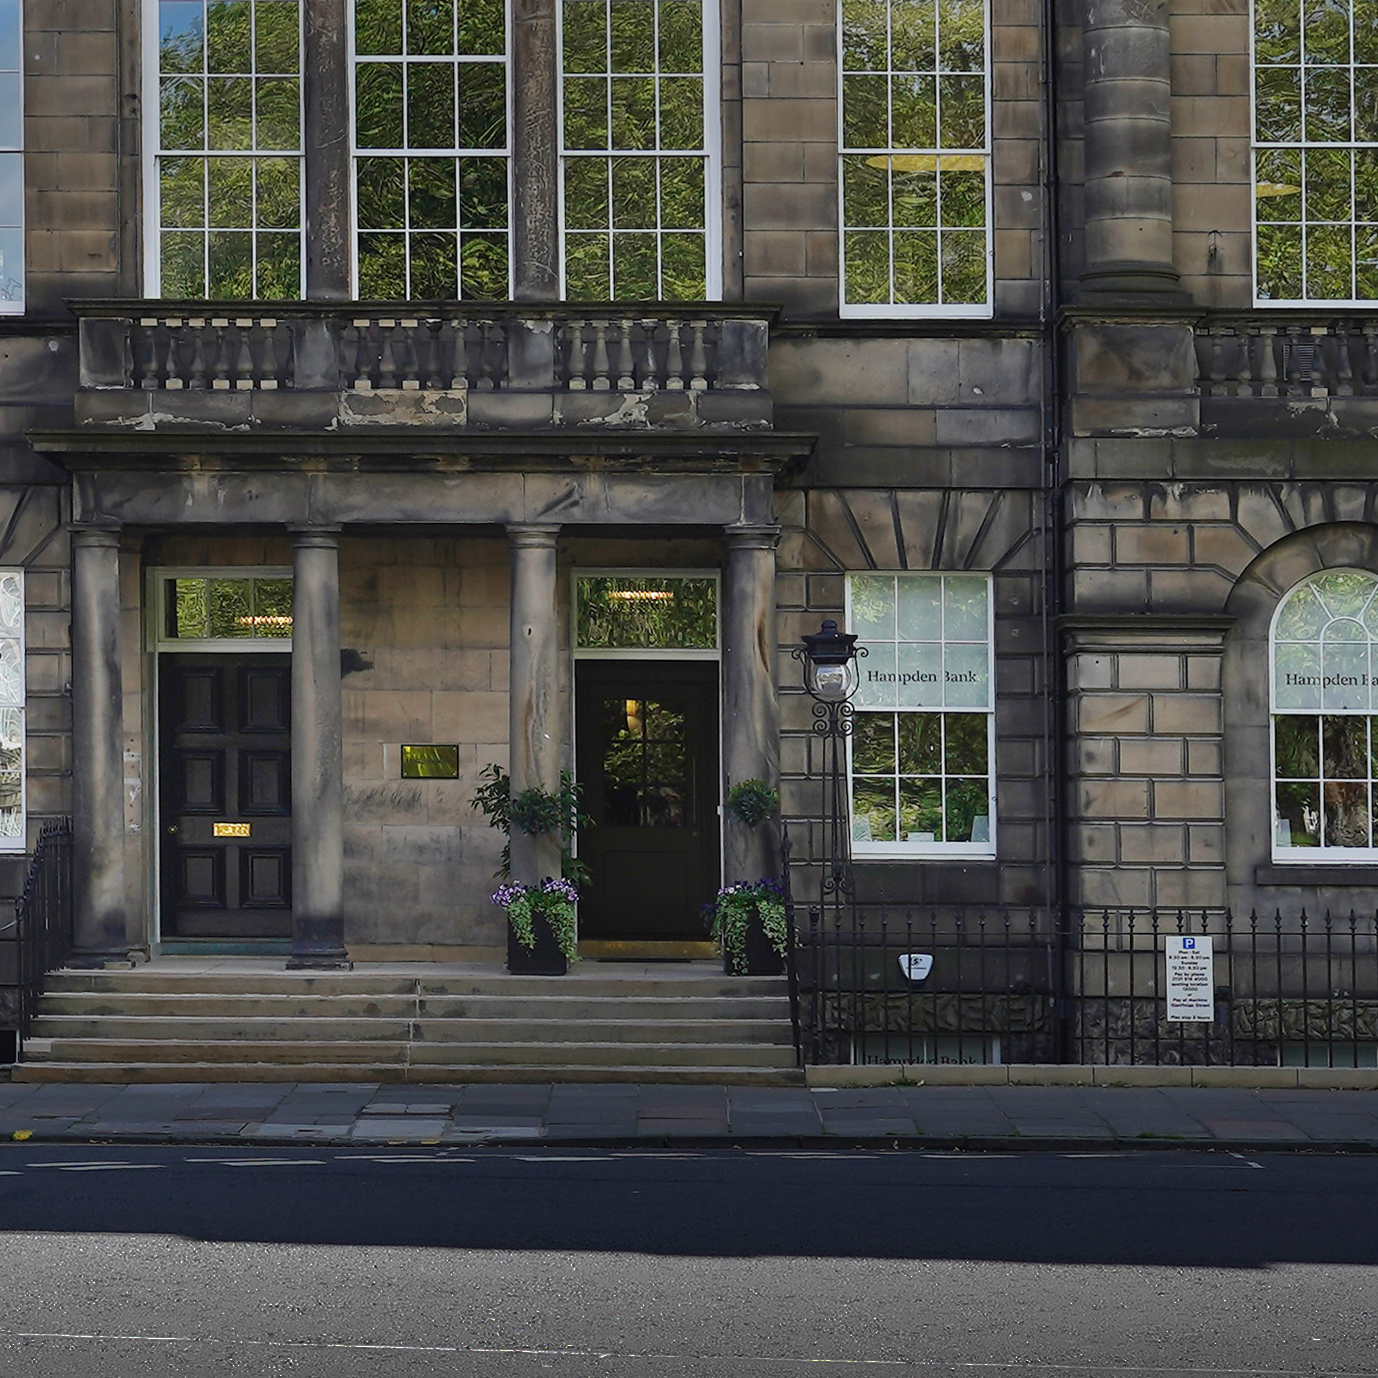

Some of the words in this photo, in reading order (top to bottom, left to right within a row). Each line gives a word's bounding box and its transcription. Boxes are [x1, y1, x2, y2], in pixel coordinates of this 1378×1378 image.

[867, 670, 937, 685] Hampden
[940, 670, 977, 683] Bank
[1286, 673, 1359, 689] Hampden
